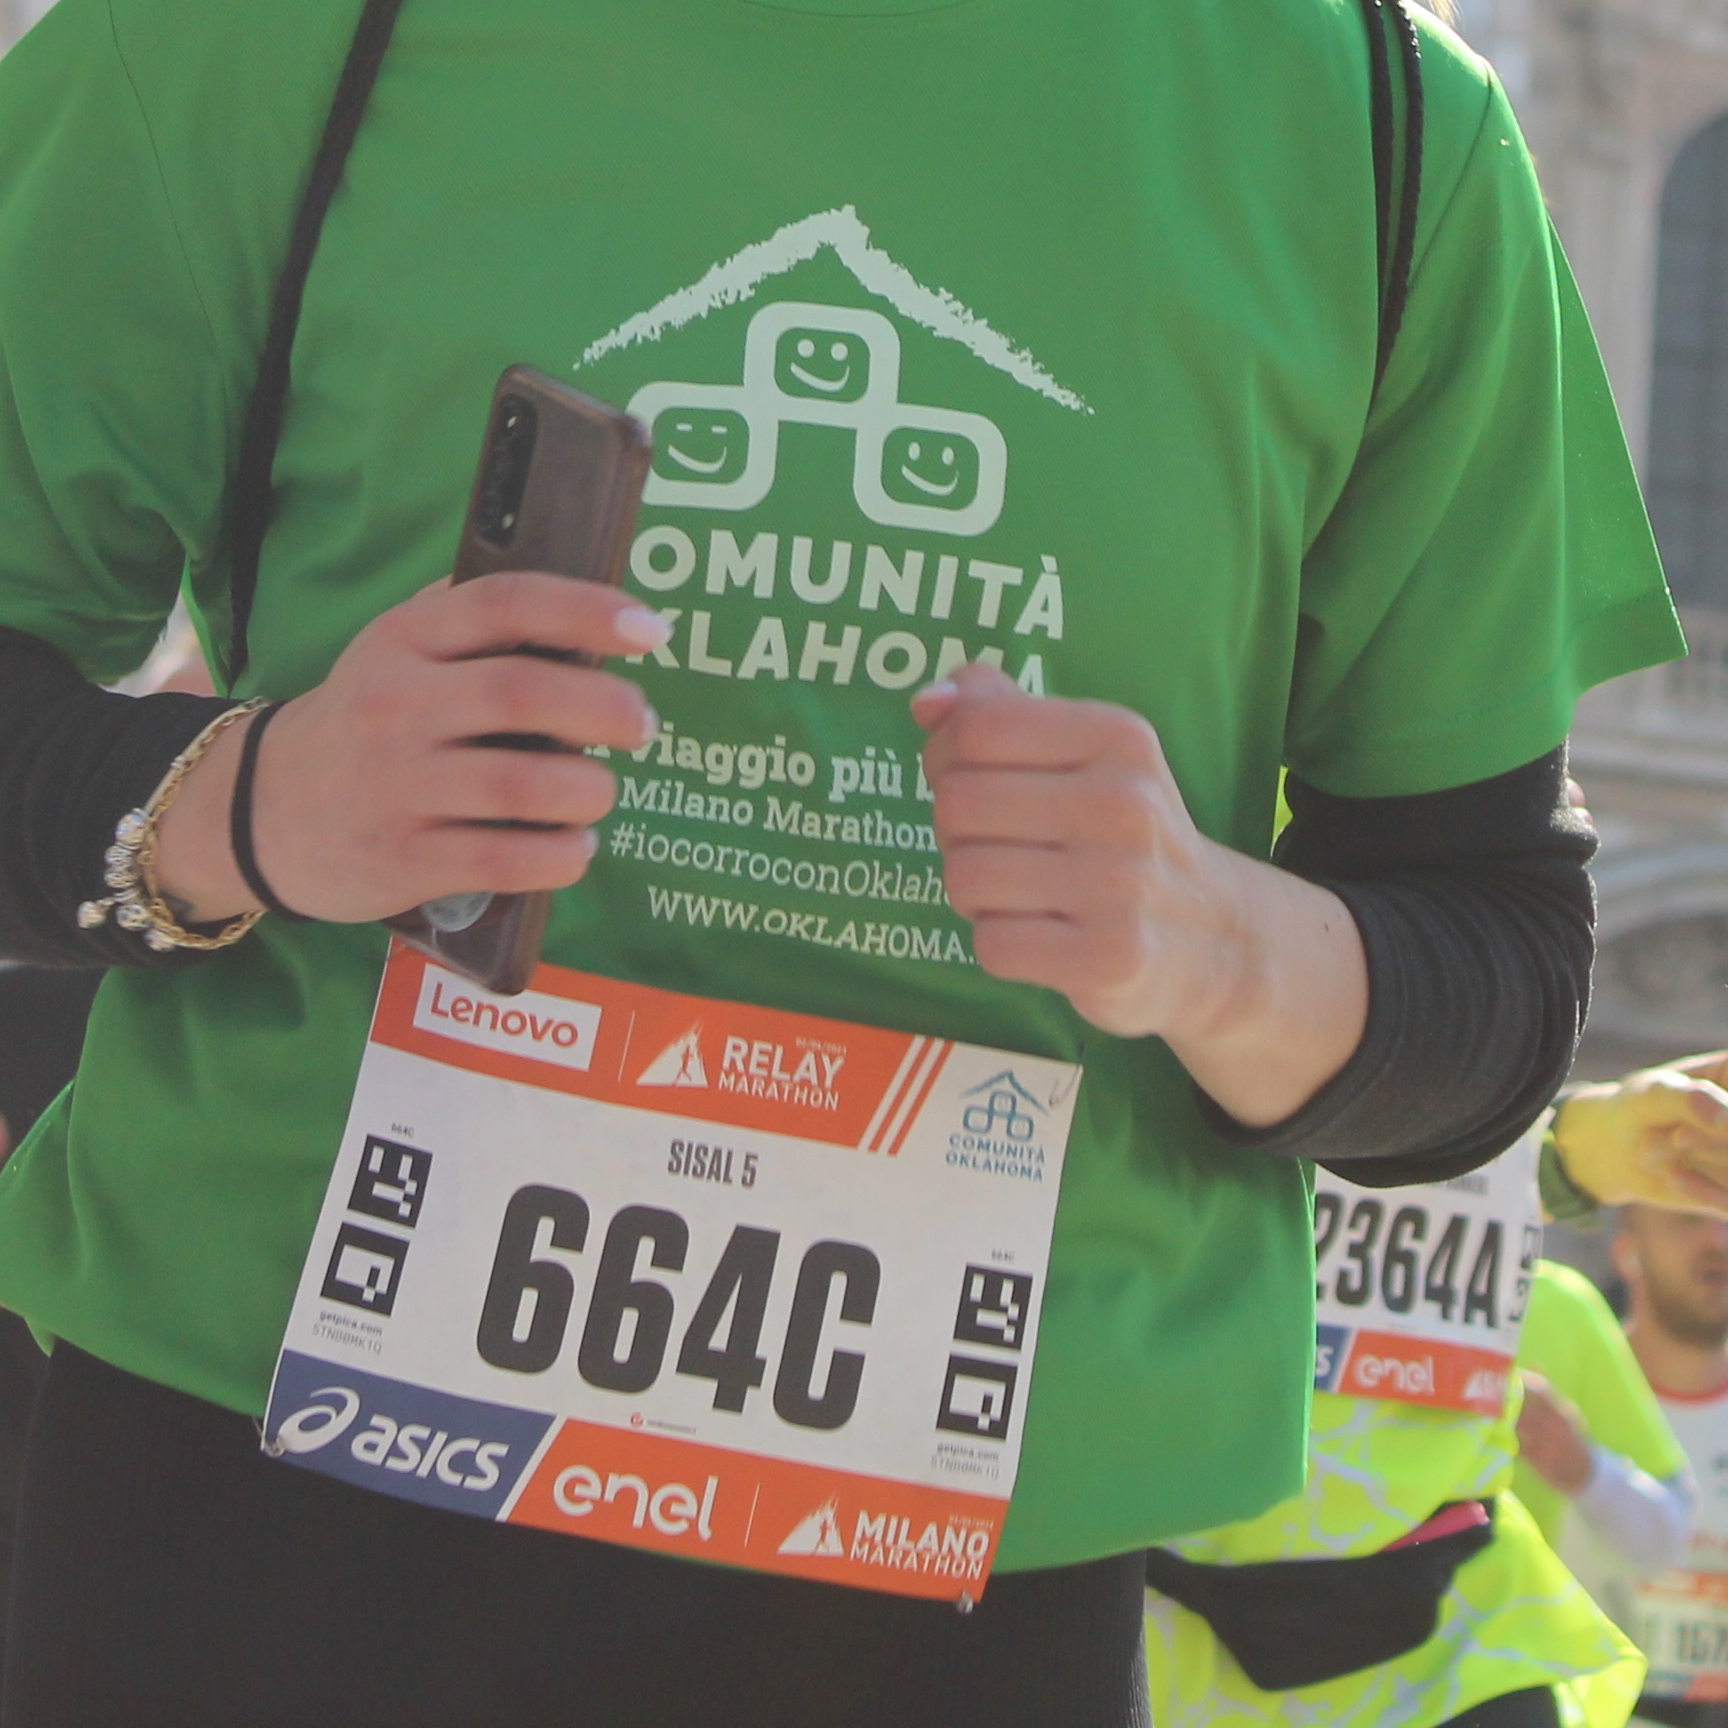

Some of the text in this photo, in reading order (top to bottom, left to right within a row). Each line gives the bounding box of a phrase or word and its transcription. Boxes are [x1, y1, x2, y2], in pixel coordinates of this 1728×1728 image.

[629, 525, 1065, 640] OMUNITÀ
[828, 746, 903, 804] più
[618, 776, 938, 853] Milano Marathon
[610, 822, 950, 907] #iocorroconOklah
[647, 884, 977, 966] WWW.OKLAHOMA.
[430, 981, 579, 1048] Lenovo
[722, 1035, 846, 1089] RELAY
[718, 1071, 840, 1112] MARATHON
[667, 1138, 759, 1189] SISAL 5
[945, 1150, 1044, 1183] OKLAHOMA
[949, 1133, 1046, 1165] COMUNITÀ
[1315, 1190, 1505, 1330] 2364A
[475, 1182, 882, 1431] 664C
[1355, 1354, 1436, 1395] enel
[552, 1464, 719, 1541] enel
[849, 1540, 984, 1581] MARATHON
[853, 1509, 990, 1561] MILANO
